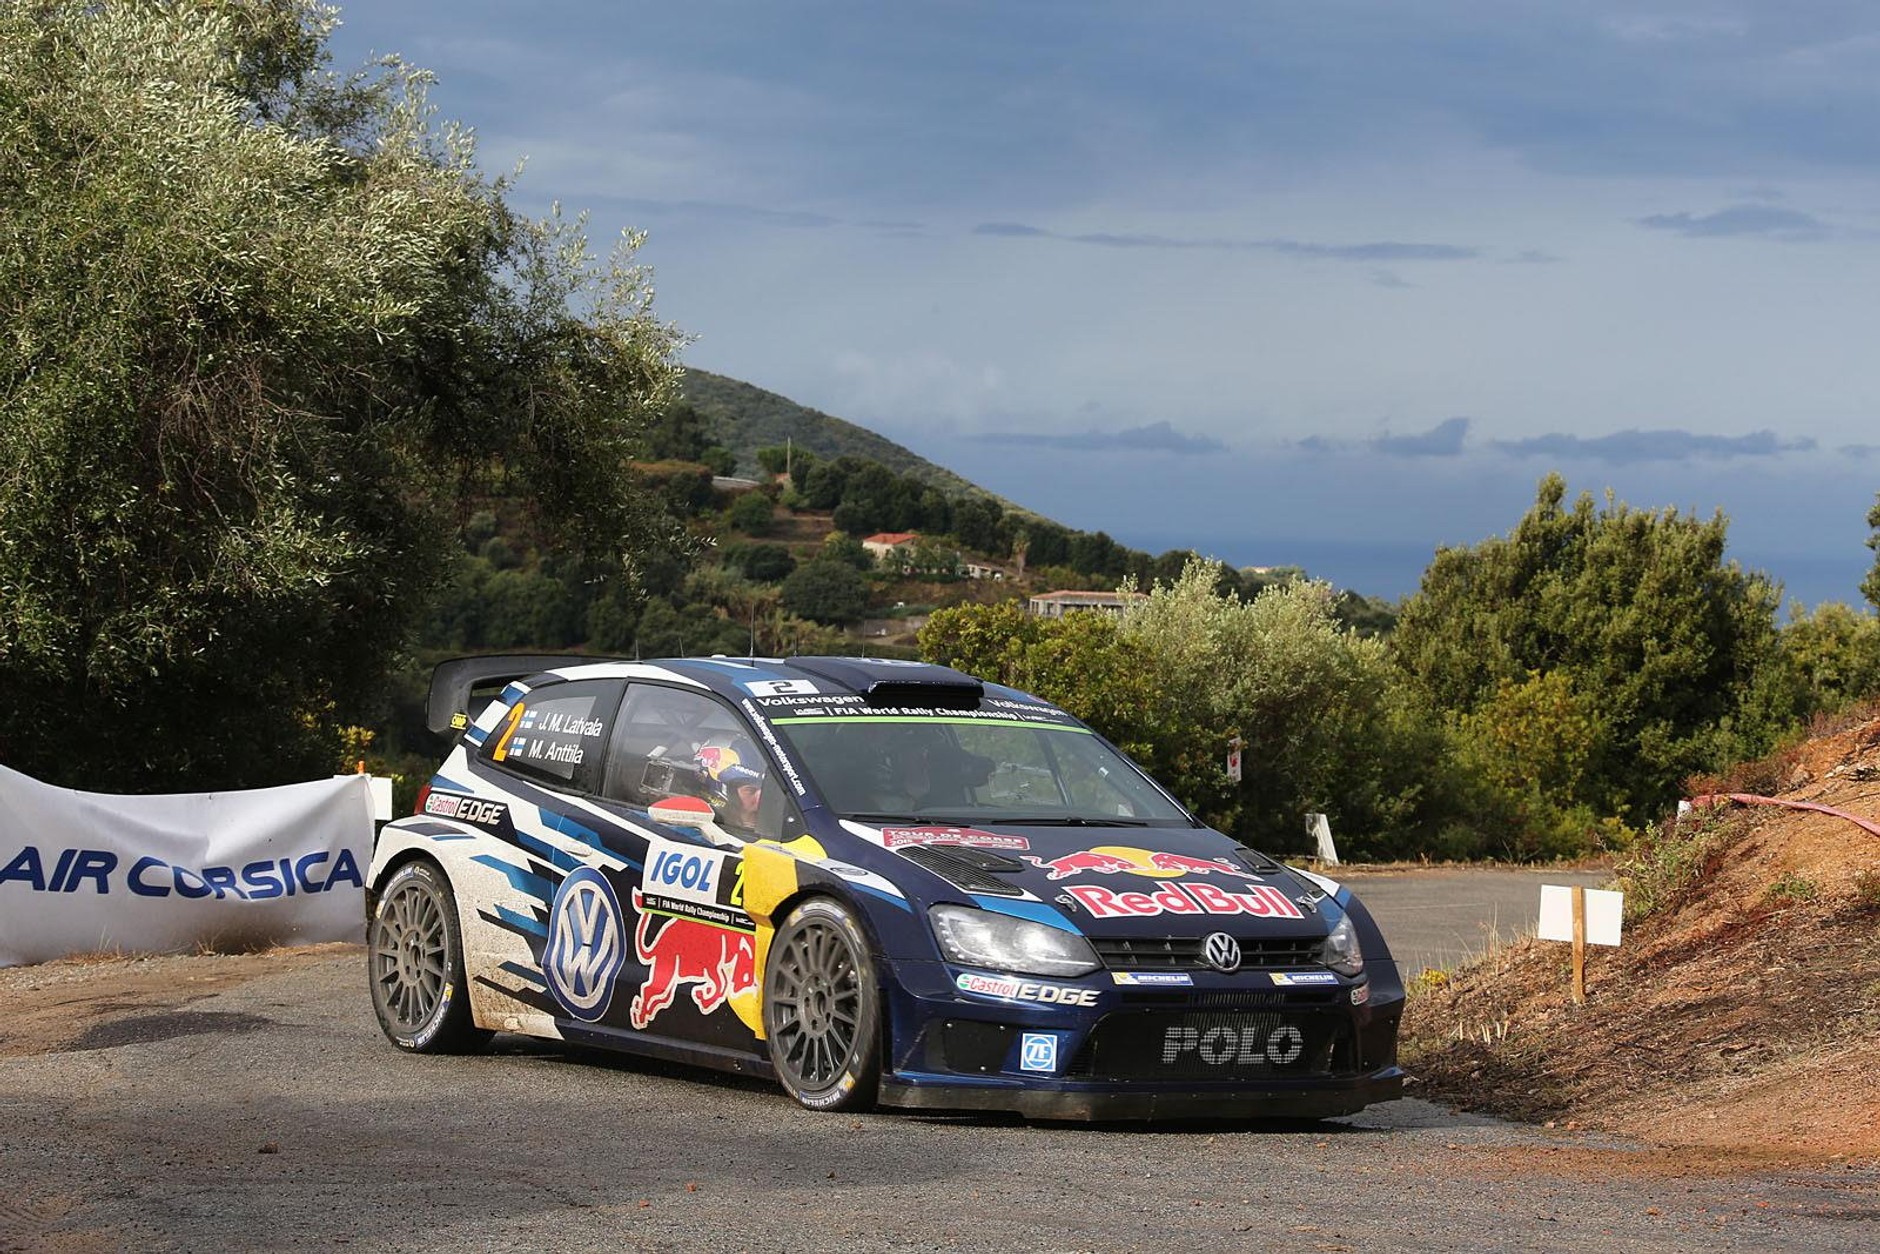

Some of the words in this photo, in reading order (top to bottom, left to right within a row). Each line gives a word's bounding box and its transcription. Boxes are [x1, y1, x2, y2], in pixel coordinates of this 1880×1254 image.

[769, 681, 798, 694] 2
[756, 694, 865, 707] Volkswagen
[987, 699, 1068, 717] Volkswagen
[833, 707, 859, 715] FIA
[859, 707, 899, 715] World
[901, 707, 933, 716] Rally
[935, 708, 1018, 721] Championship
[493, 702, 525, 761] 2
[562, 715, 603, 737] Latvala
[528, 740, 544, 759] M.
[544, 741, 584, 764] Anttila
[432, 796, 458, 817] Castrol
[456, 799, 507, 825] EDGE
[888, 830, 935, 838] TOUR
[0, 846, 118, 894] AIR
[127, 849, 363, 899] CORSICA
[650, 851, 714, 892] IGOL
[662, 900, 671, 909] FIA
[671, 901, 684, 912] World
[1138, 974, 1188, 982] MICHELIN
[1292, 974, 1334, 982] MICHELIN
[970, 977, 1016, 996] Castrol
[1017, 983, 1102, 1007] EDGE
[1027, 1042, 1052, 1062] ZF
[1162, 1027, 1303, 1064] POLO
